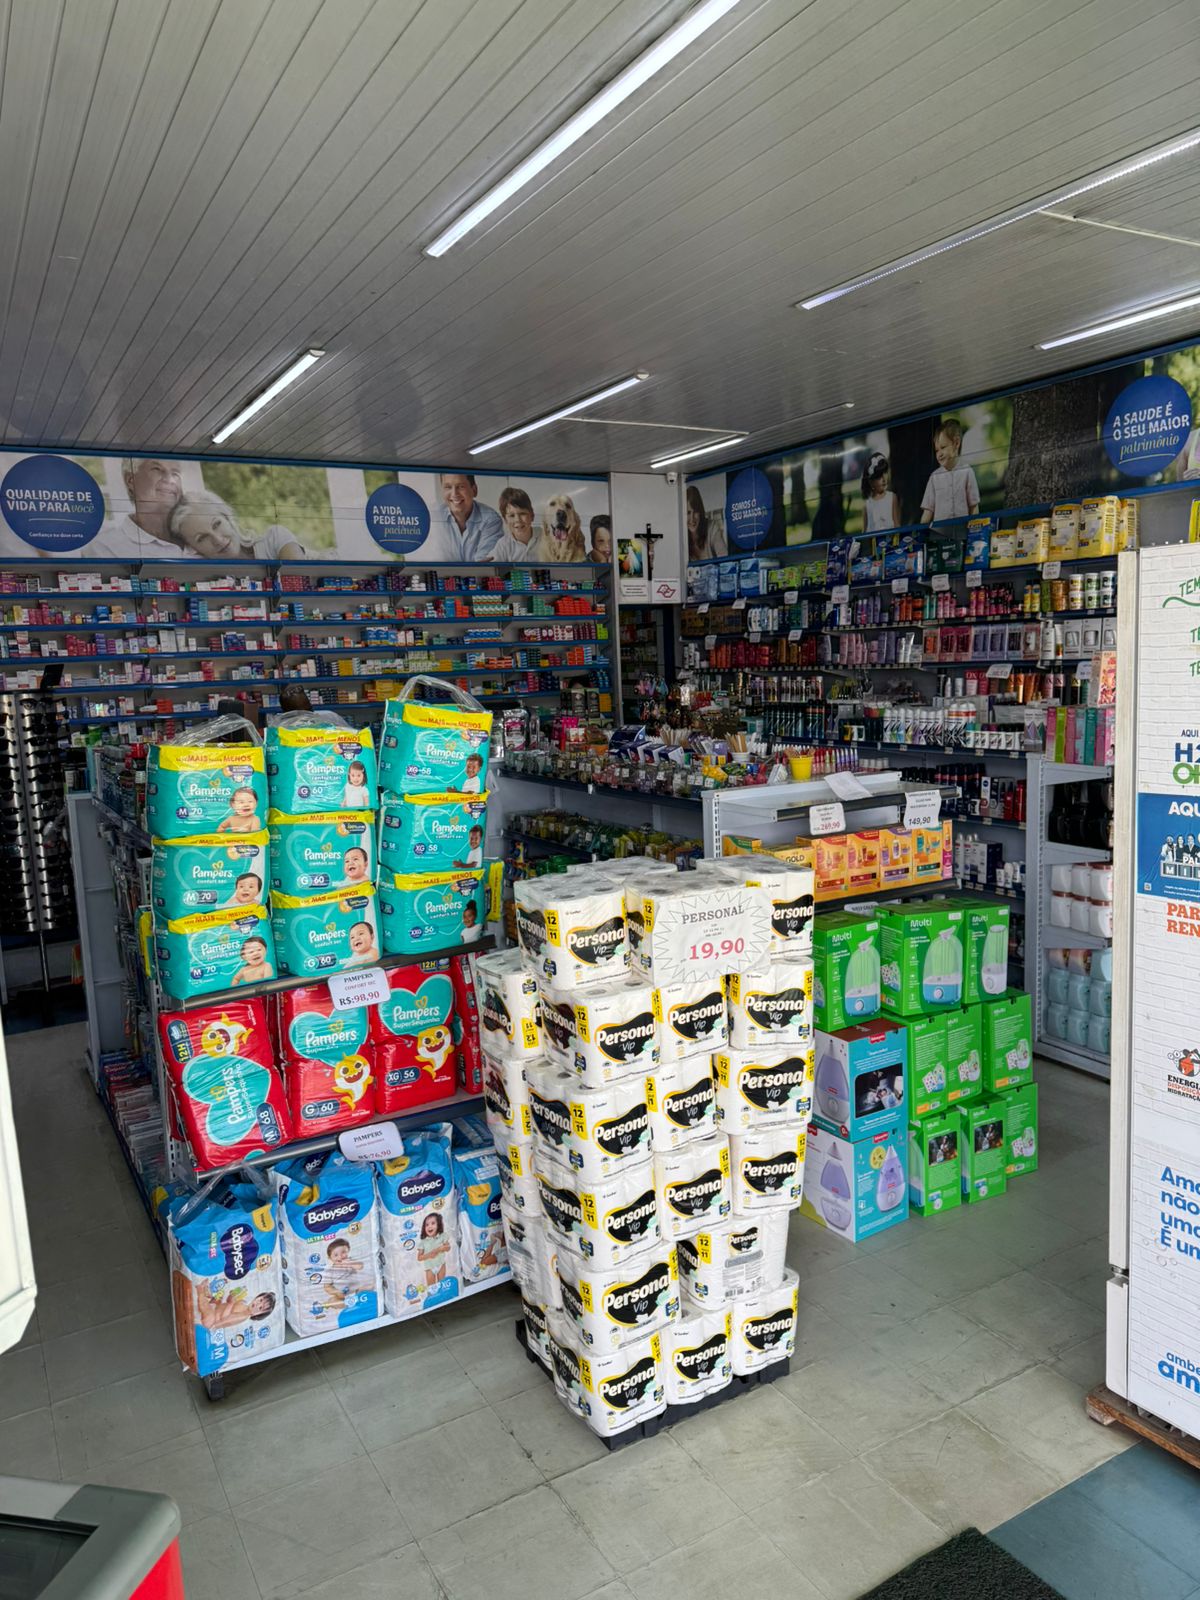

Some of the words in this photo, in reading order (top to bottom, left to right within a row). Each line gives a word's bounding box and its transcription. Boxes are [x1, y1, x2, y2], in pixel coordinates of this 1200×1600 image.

[1113, 416, 1121, 428] A
[1124, 406, 1163, 426] SAUDE
[1165, 400, 1173, 417] É
[1113, 429, 1121, 441] O
[1124, 423, 1146, 439] SEU
[1148, 414, 1190, 434] MAIOR
[1120, 434, 1179, 460] patrimônio
[6, 488, 74, 501] QUALIDADE
[77, 492, 92, 501] DE
[6, 500, 37, 511] VIDA
[39, 502, 71, 512] PARA
[71, 503, 95, 513] você
[373, 505, 379, 514] A
[380, 506, 402, 515] VIDA
[373, 515, 396, 525] PEDE
[398, 516, 419, 525] MAIS
[1181, 729, 1199, 738] AQUI
[426, 744, 464, 760] Pampers
[306, 762, 344, 776] Pampers
[190, 784, 231, 799] Pampers
[179, 808, 187, 816] M
[432, 820, 467, 834] Pampers
[909, 817, 931, 825] 149,90
[304, 848, 341, 862] Pampers
[785, 855, 805, 863] GOLD
[192, 866, 233, 880] Pampers
[425, 901, 462, 914] Pampers
[547, 916, 557, 925] 12
[682, 906, 745, 925] PERSONAL
[786, 919, 798, 928] Vip
[910, 918, 932, 927] Multi
[309, 929, 346, 944] Pampers
[201, 941, 240, 956] Pampers
[593, 945, 607, 955] Vip
[689, 938, 745, 960] 19,90
[307, 959, 315, 967] G
[344, 973, 373, 982] PAMPERS
[745, 996, 806, 1012] Personal
[393, 1006, 440, 1020] Pampers
[577, 1011, 586, 1020] 12
[670, 1001, 726, 1026] Personal
[769, 1012, 783, 1022] Vip
[693, 1020, 706, 1031] Vip
[305, 1030, 358, 1048] Pampers
[596, 1022, 656, 1046] Personal
[177, 1043, 189, 1061] 12H
[622, 1041, 635, 1051] Vip
[388, 1072, 400, 1081] XG
[404, 1070, 415, 1078] 56
[739, 1070, 806, 1090] Personal
[223, 1067, 246, 1124] Pampers
[765, 1088, 781, 1098] Vip
[305, 1104, 315, 1114] G
[321, 1103, 334, 1112] 60
[573, 1109, 583, 1118] 12
[686, 1106, 698, 1118] Vip
[259, 1110, 271, 1124] 68
[265, 1130, 276, 1141] M
[354, 1131, 383, 1142] PAMPERS
[619, 1134, 632, 1145] Vip
[511, 1151, 519, 1159] 12
[742, 1158, 798, 1177] Personal
[764, 1175, 777, 1185] Vip
[401, 1179, 441, 1197] Babysec
[665, 1175, 724, 1202] Personal
[584, 1199, 594, 1208] 12
[691, 1197, 704, 1207] Vip
[308, 1203, 356, 1224] Babysec
[628, 1221, 641, 1232] Vip
[700, 1239, 709, 1247] 12
[1161, 1227, 1171, 1247] É
[231, 1227, 244, 1276] Babysec
[441, 1280, 451, 1289] XG
[582, 1286, 591, 1296] 12
[604, 1268, 672, 1312] Personal
[360, 1294, 368, 1303] G
[633, 1301, 649, 1314] Vip
[213, 1346, 225, 1360] M
[674, 1340, 728, 1367] Personal
[582, 1364, 591, 1374] 12
[600, 1362, 657, 1397] Personal
[625, 1387, 637, 1398] Vip
